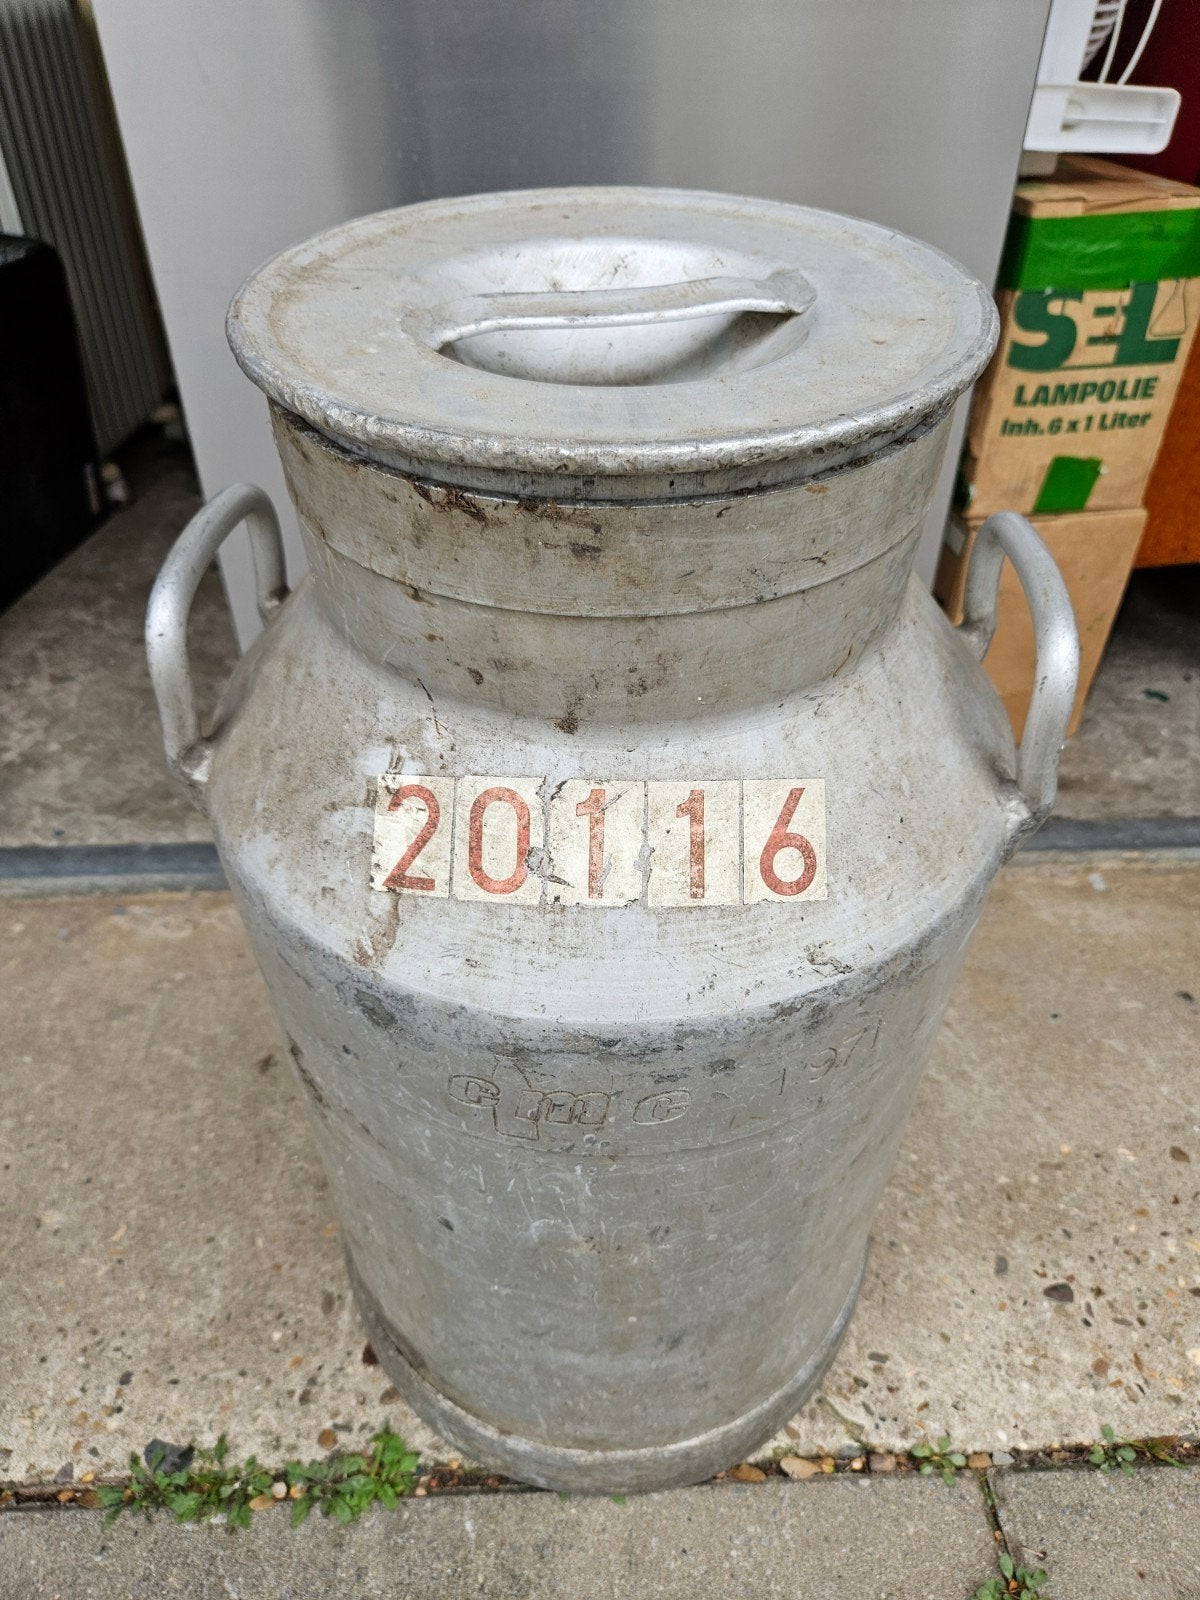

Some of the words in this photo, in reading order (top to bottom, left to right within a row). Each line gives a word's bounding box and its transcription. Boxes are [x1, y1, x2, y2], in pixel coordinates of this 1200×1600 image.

[1007, 282, 1181, 372] SEL
[1014, 376, 1158, 407] LAMPOLIE
[1000, 417, 1043, 437] Inh.
[1049, 416, 1063, 434] 6
[1067, 418, 1080, 432] x
[1084, 415, 1094, 431] 1
[1100, 411, 1152, 431] Liter
[381, 784, 818, 899] 20116
